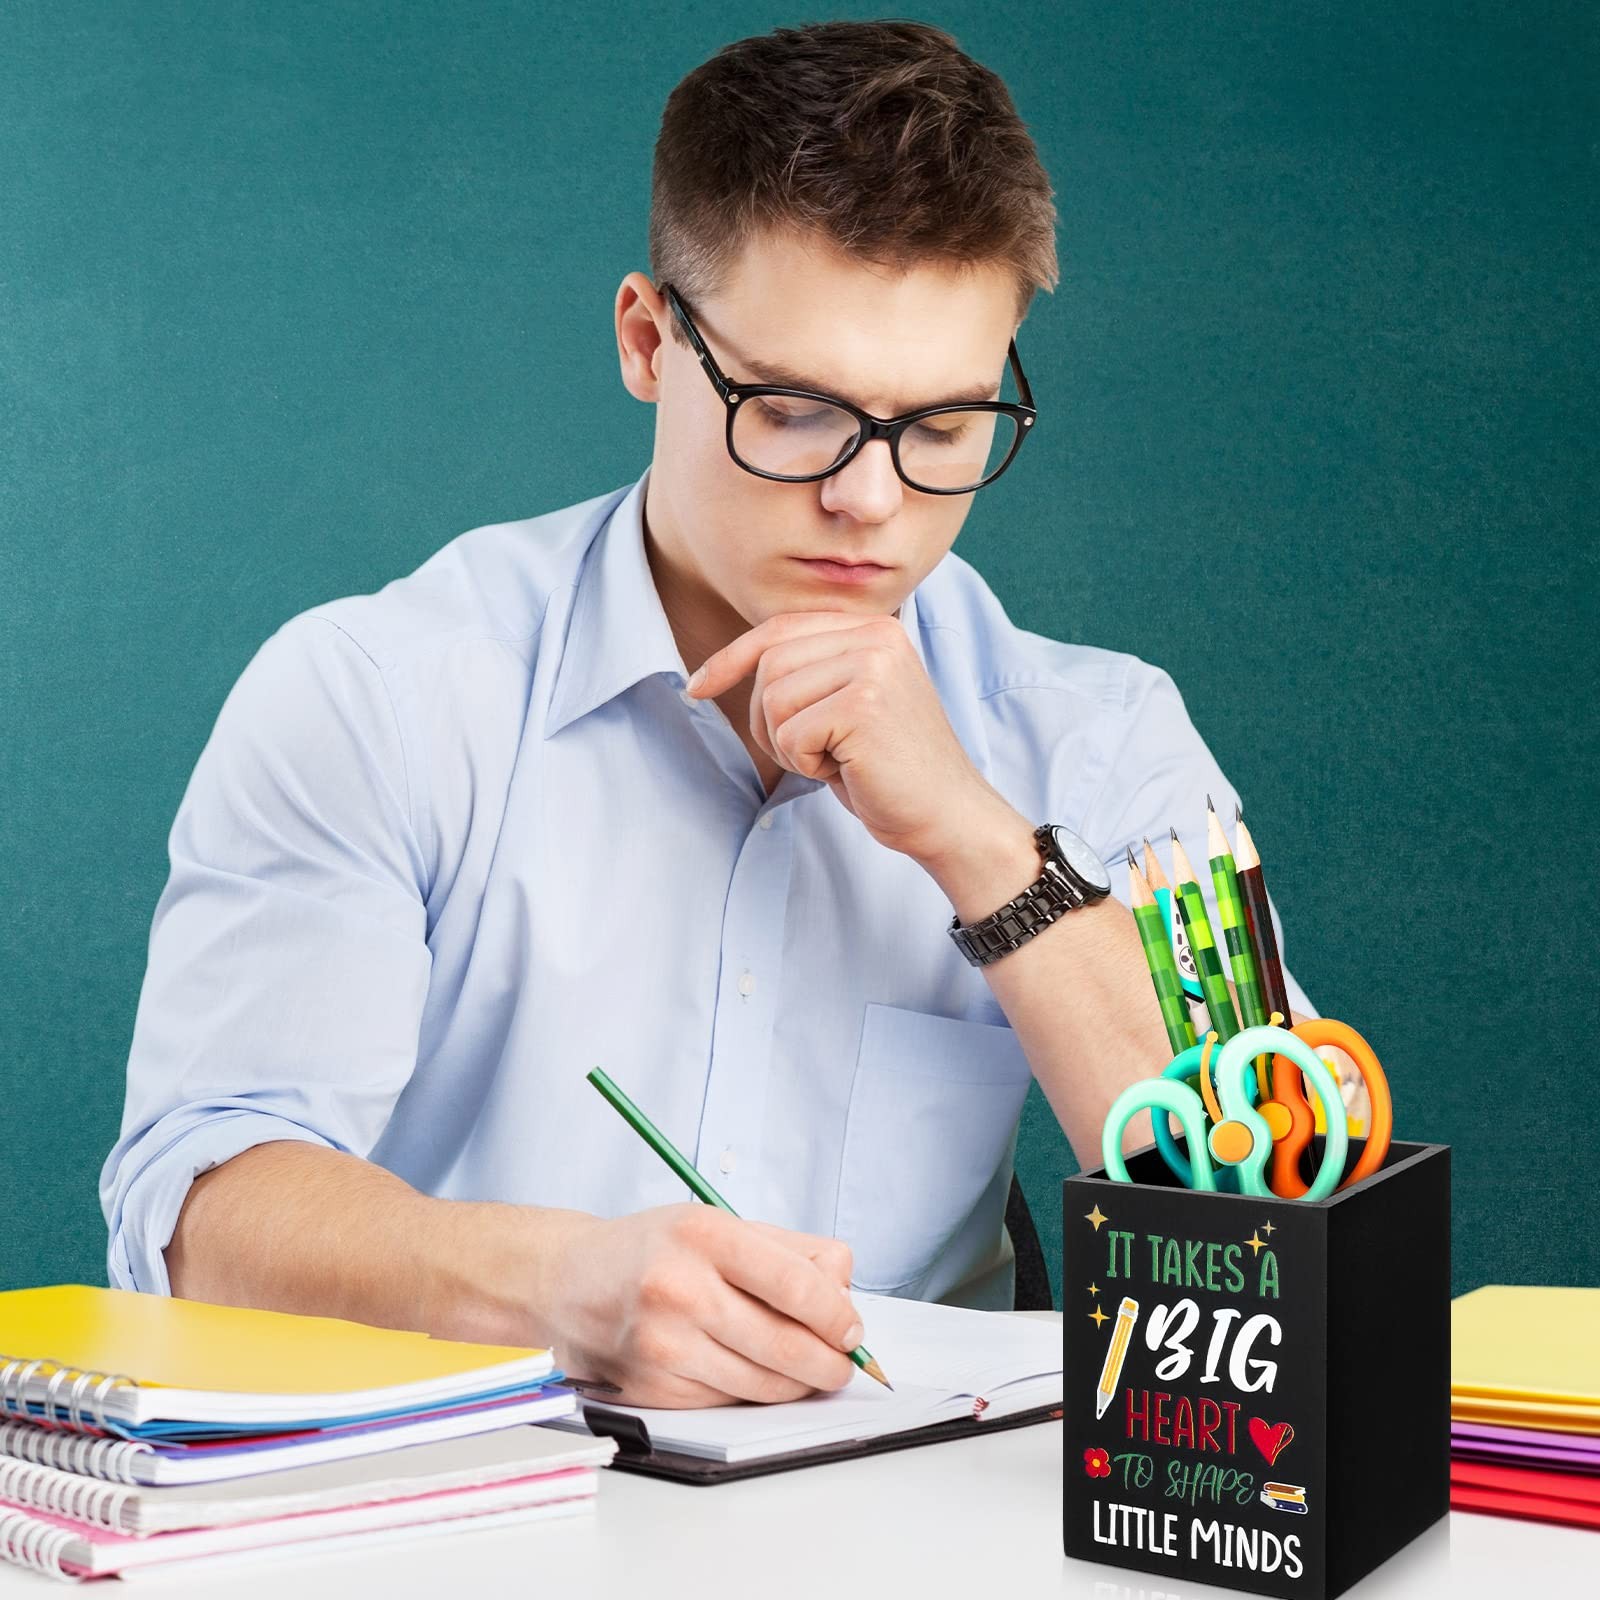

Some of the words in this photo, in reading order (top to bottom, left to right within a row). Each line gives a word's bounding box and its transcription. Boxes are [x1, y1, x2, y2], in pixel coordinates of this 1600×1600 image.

[1106, 1231, 1135, 1278] IT
[1147, 1235, 1244, 1292] TAKES
[1259, 1251, 1279, 1298] A
[1145, 1298, 1282, 1393] BIG
[1125, 1387, 1241, 1455] HEART
[1114, 1453, 1153, 1489] TO
[1165, 1460, 1255, 1505] SHAPE
[1093, 1500, 1178, 1557] LITTLE
[1190, 1517, 1303, 1579] MINDS
